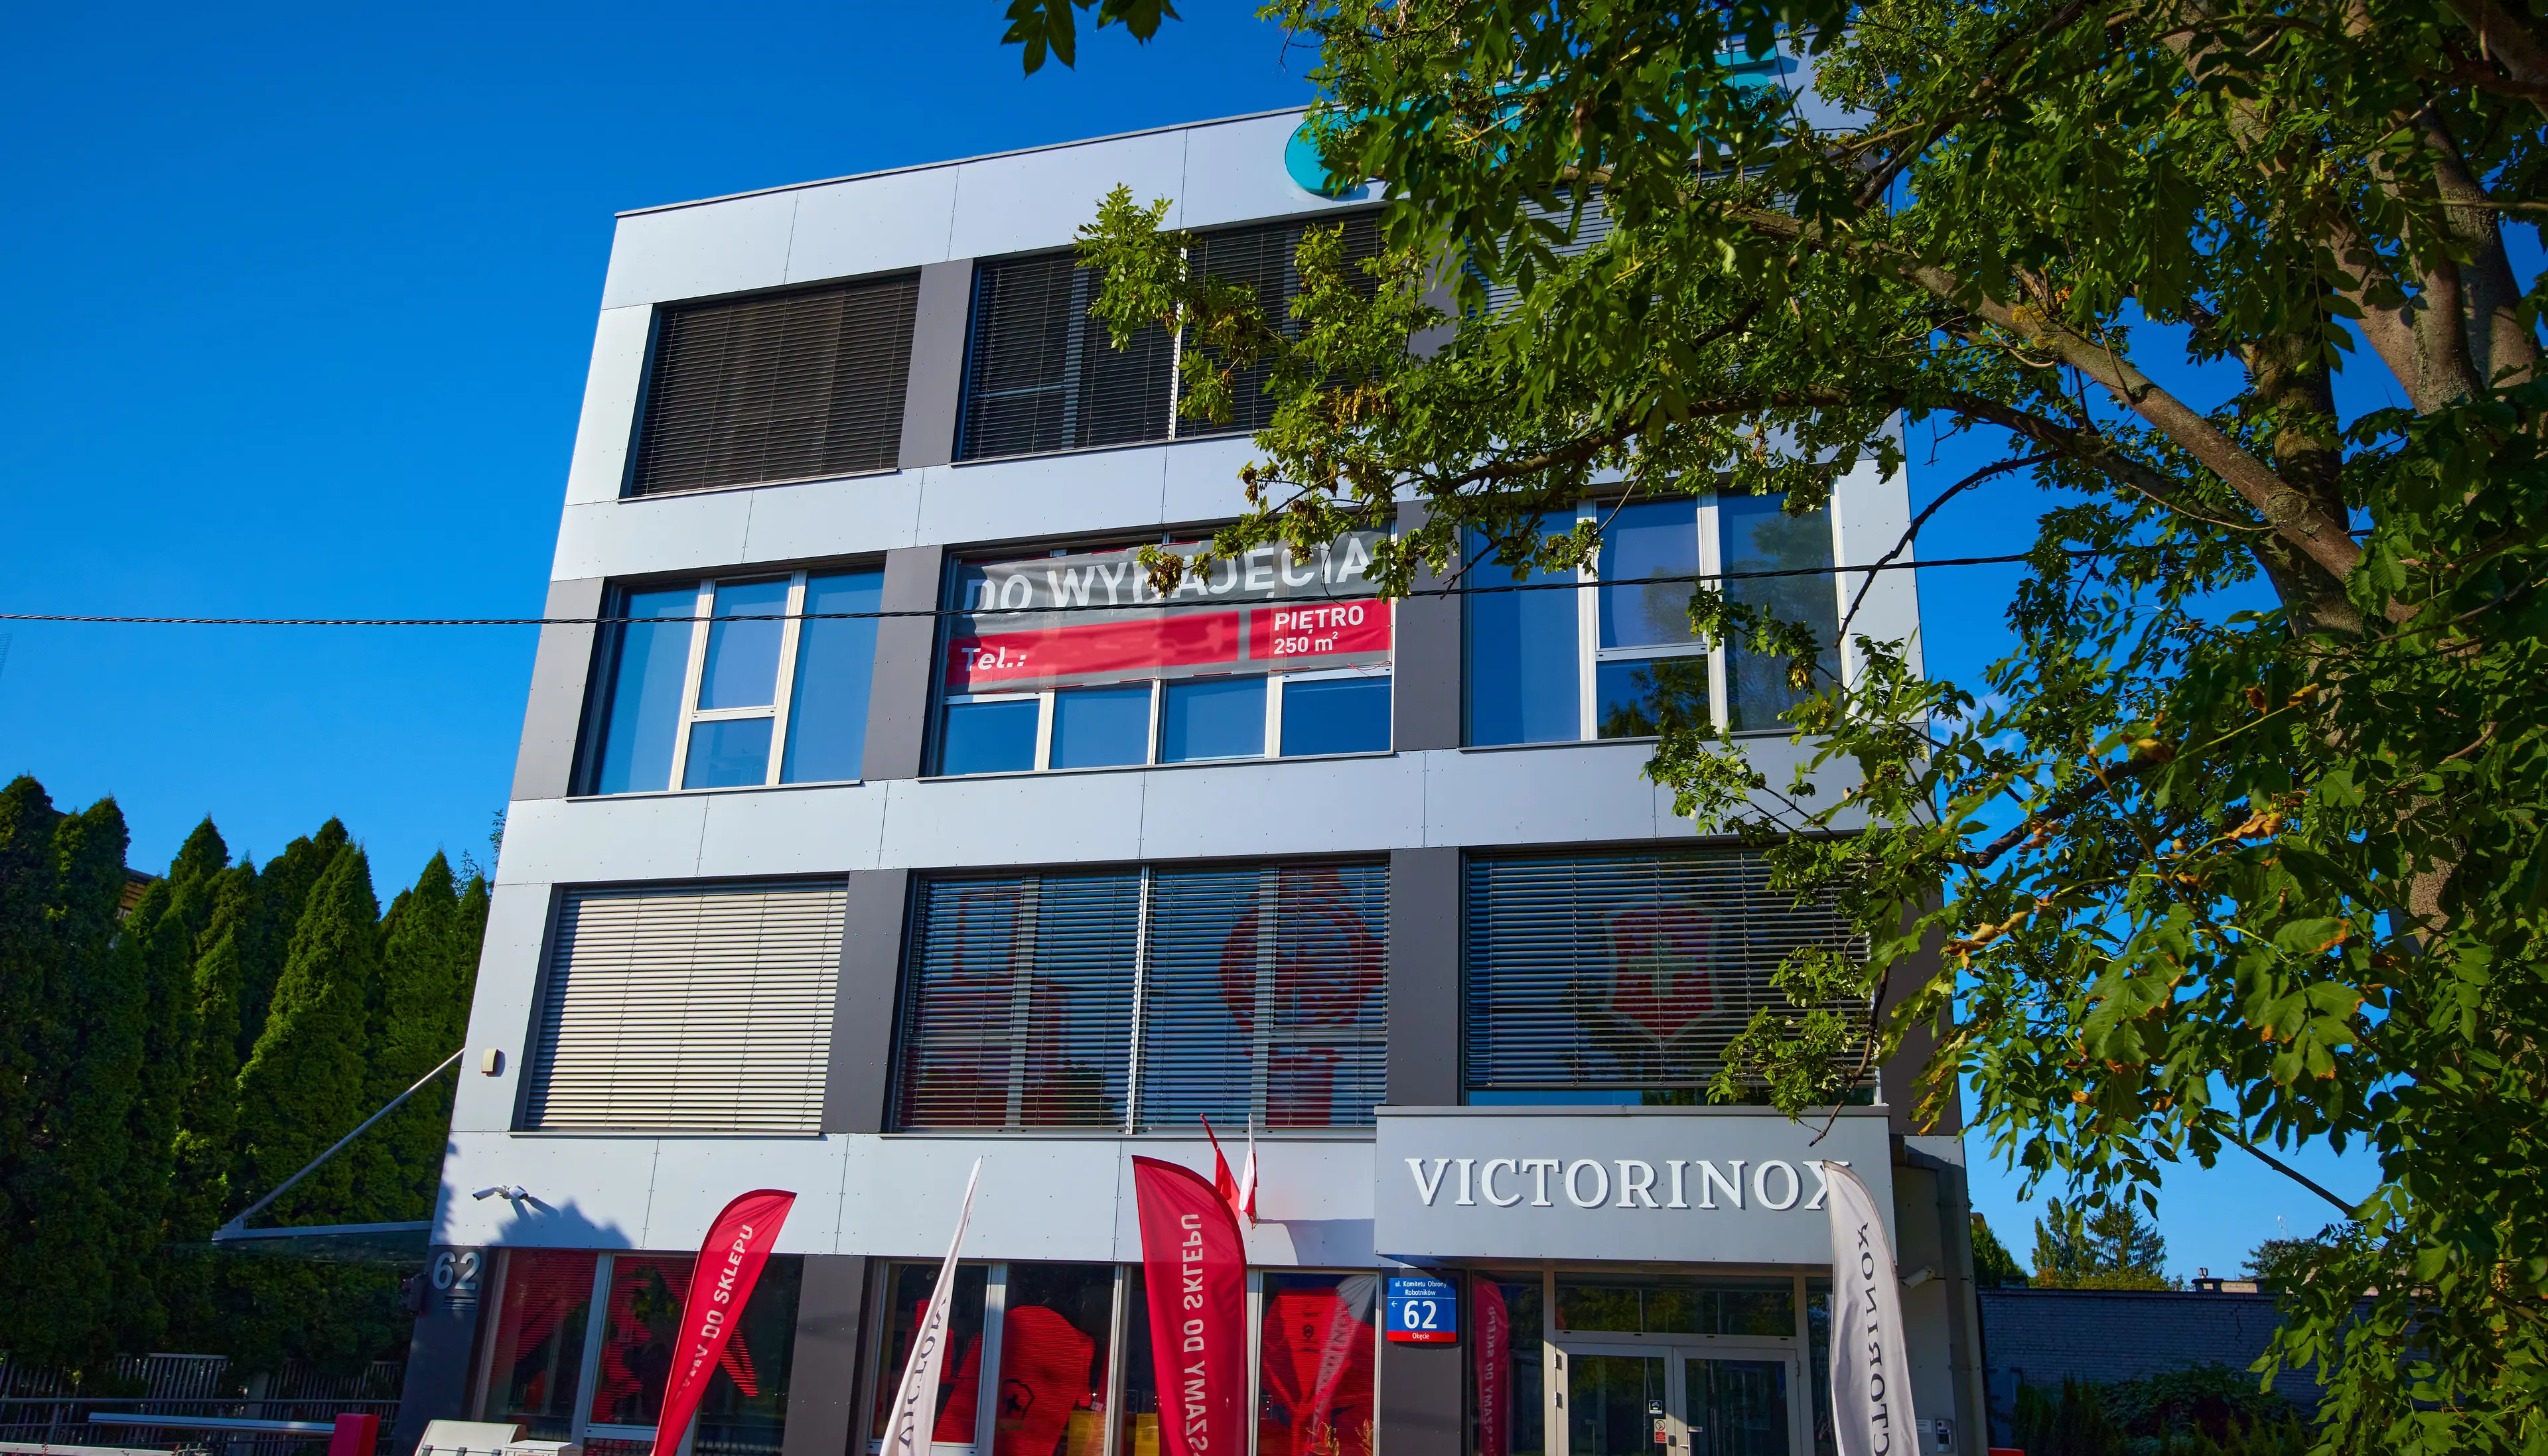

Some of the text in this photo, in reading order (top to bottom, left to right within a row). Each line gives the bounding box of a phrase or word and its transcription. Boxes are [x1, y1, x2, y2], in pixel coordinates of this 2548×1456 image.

[963, 574, 1033, 618] DO
[1274, 605, 1364, 635] PIĘTRO
[962, 646, 1027, 672] Tel.:
[1273, 636, 1309, 655] 250
[1404, 1158, 1850, 1210] VICTORINOX
[433, 1251, 481, 1290] 62
[701, 1224, 753, 1339] DO SKLEPU
[1427, 1280, 1447, 1289] Obrony
[1403, 1299, 1437, 1329] 62
